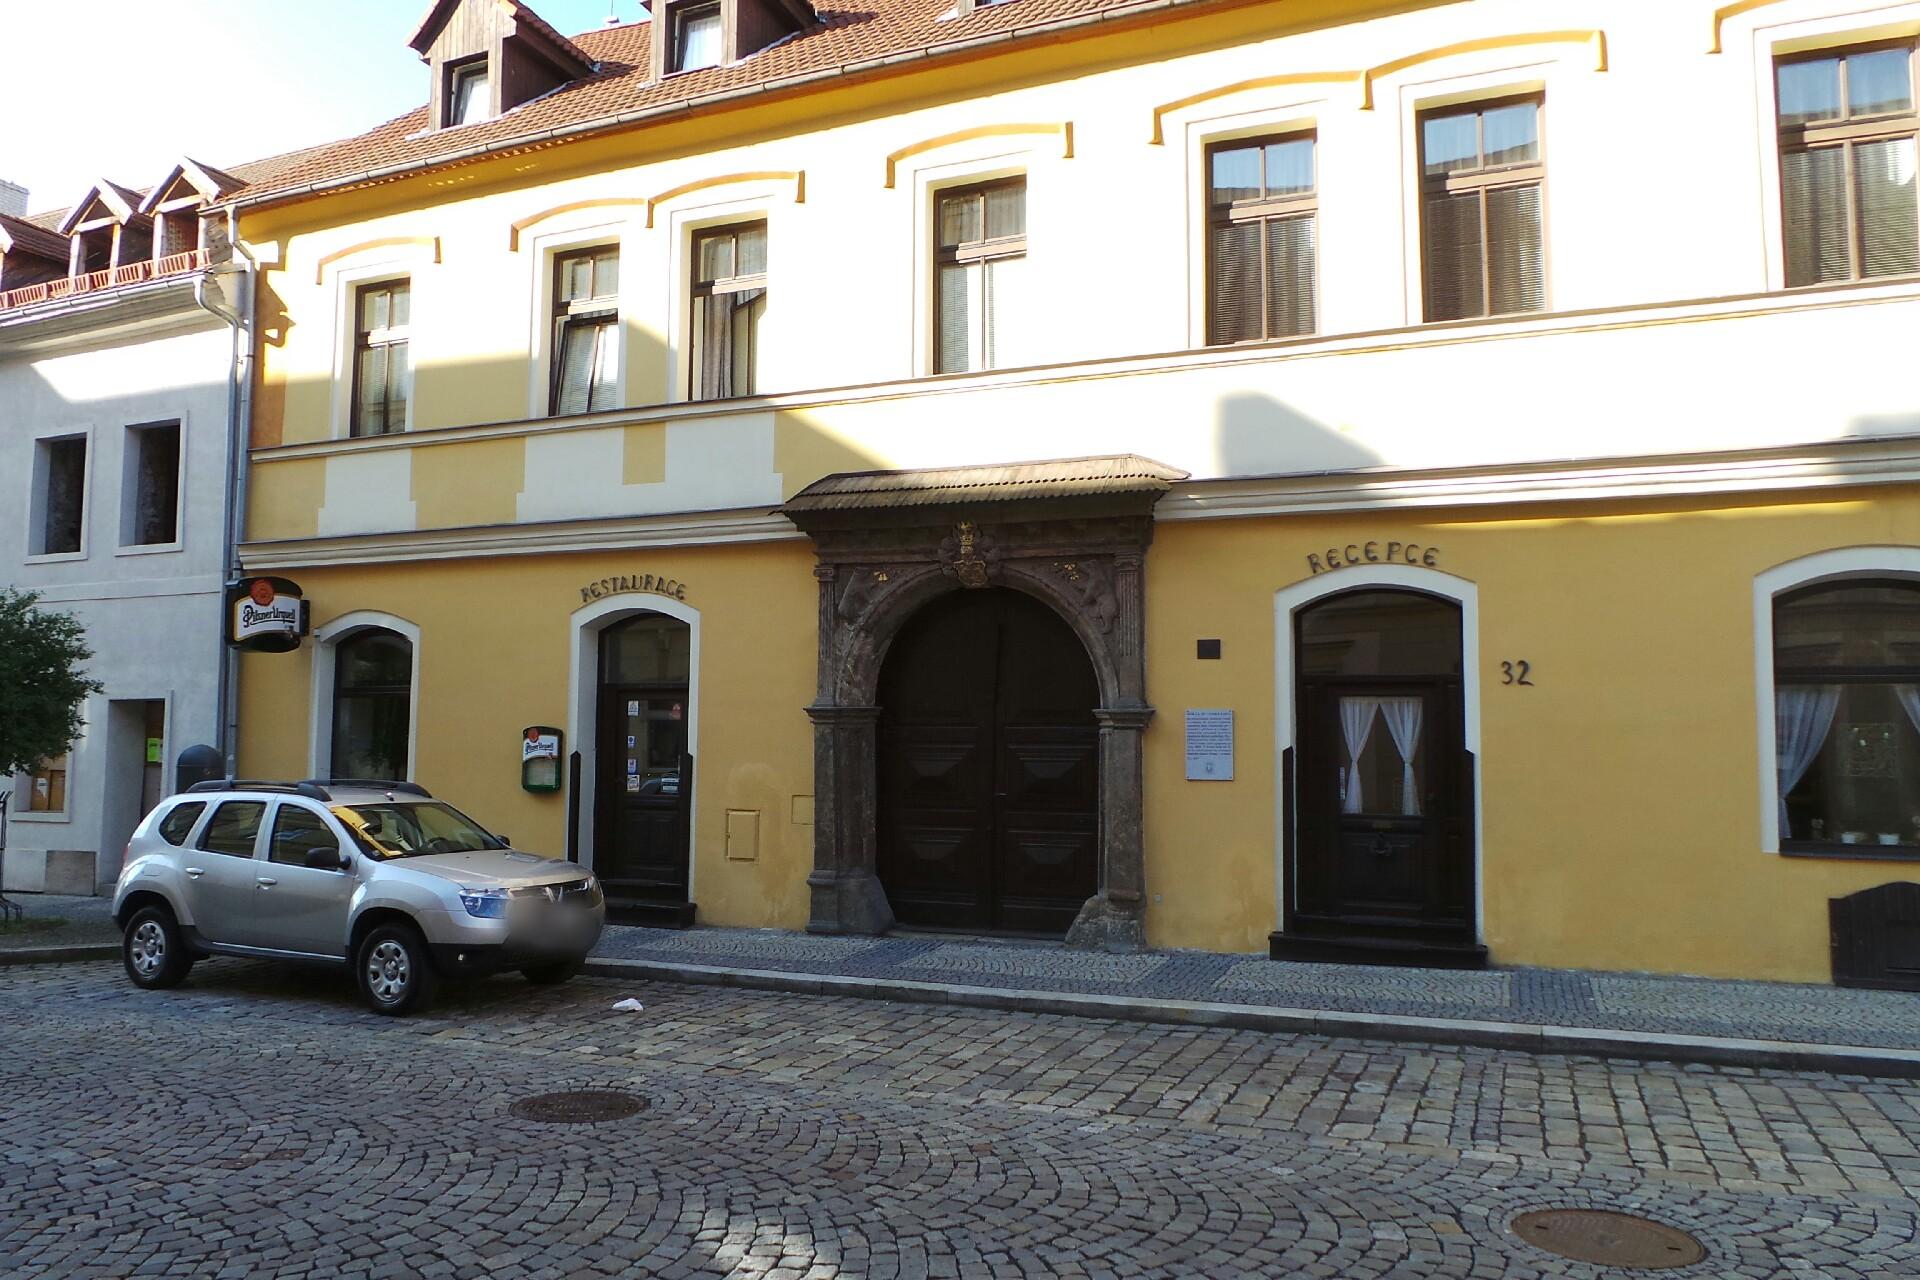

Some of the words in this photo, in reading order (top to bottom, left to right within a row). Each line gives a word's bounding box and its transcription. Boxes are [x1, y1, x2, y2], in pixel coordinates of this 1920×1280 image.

[1307, 541, 1440, 574] RECEPCE
[580, 574, 687, 602] RESTAURACE
[243, 605, 273, 628] Pilsner
[273, 605, 296, 623] Urquell
[1501, 660, 1535, 687] 32
